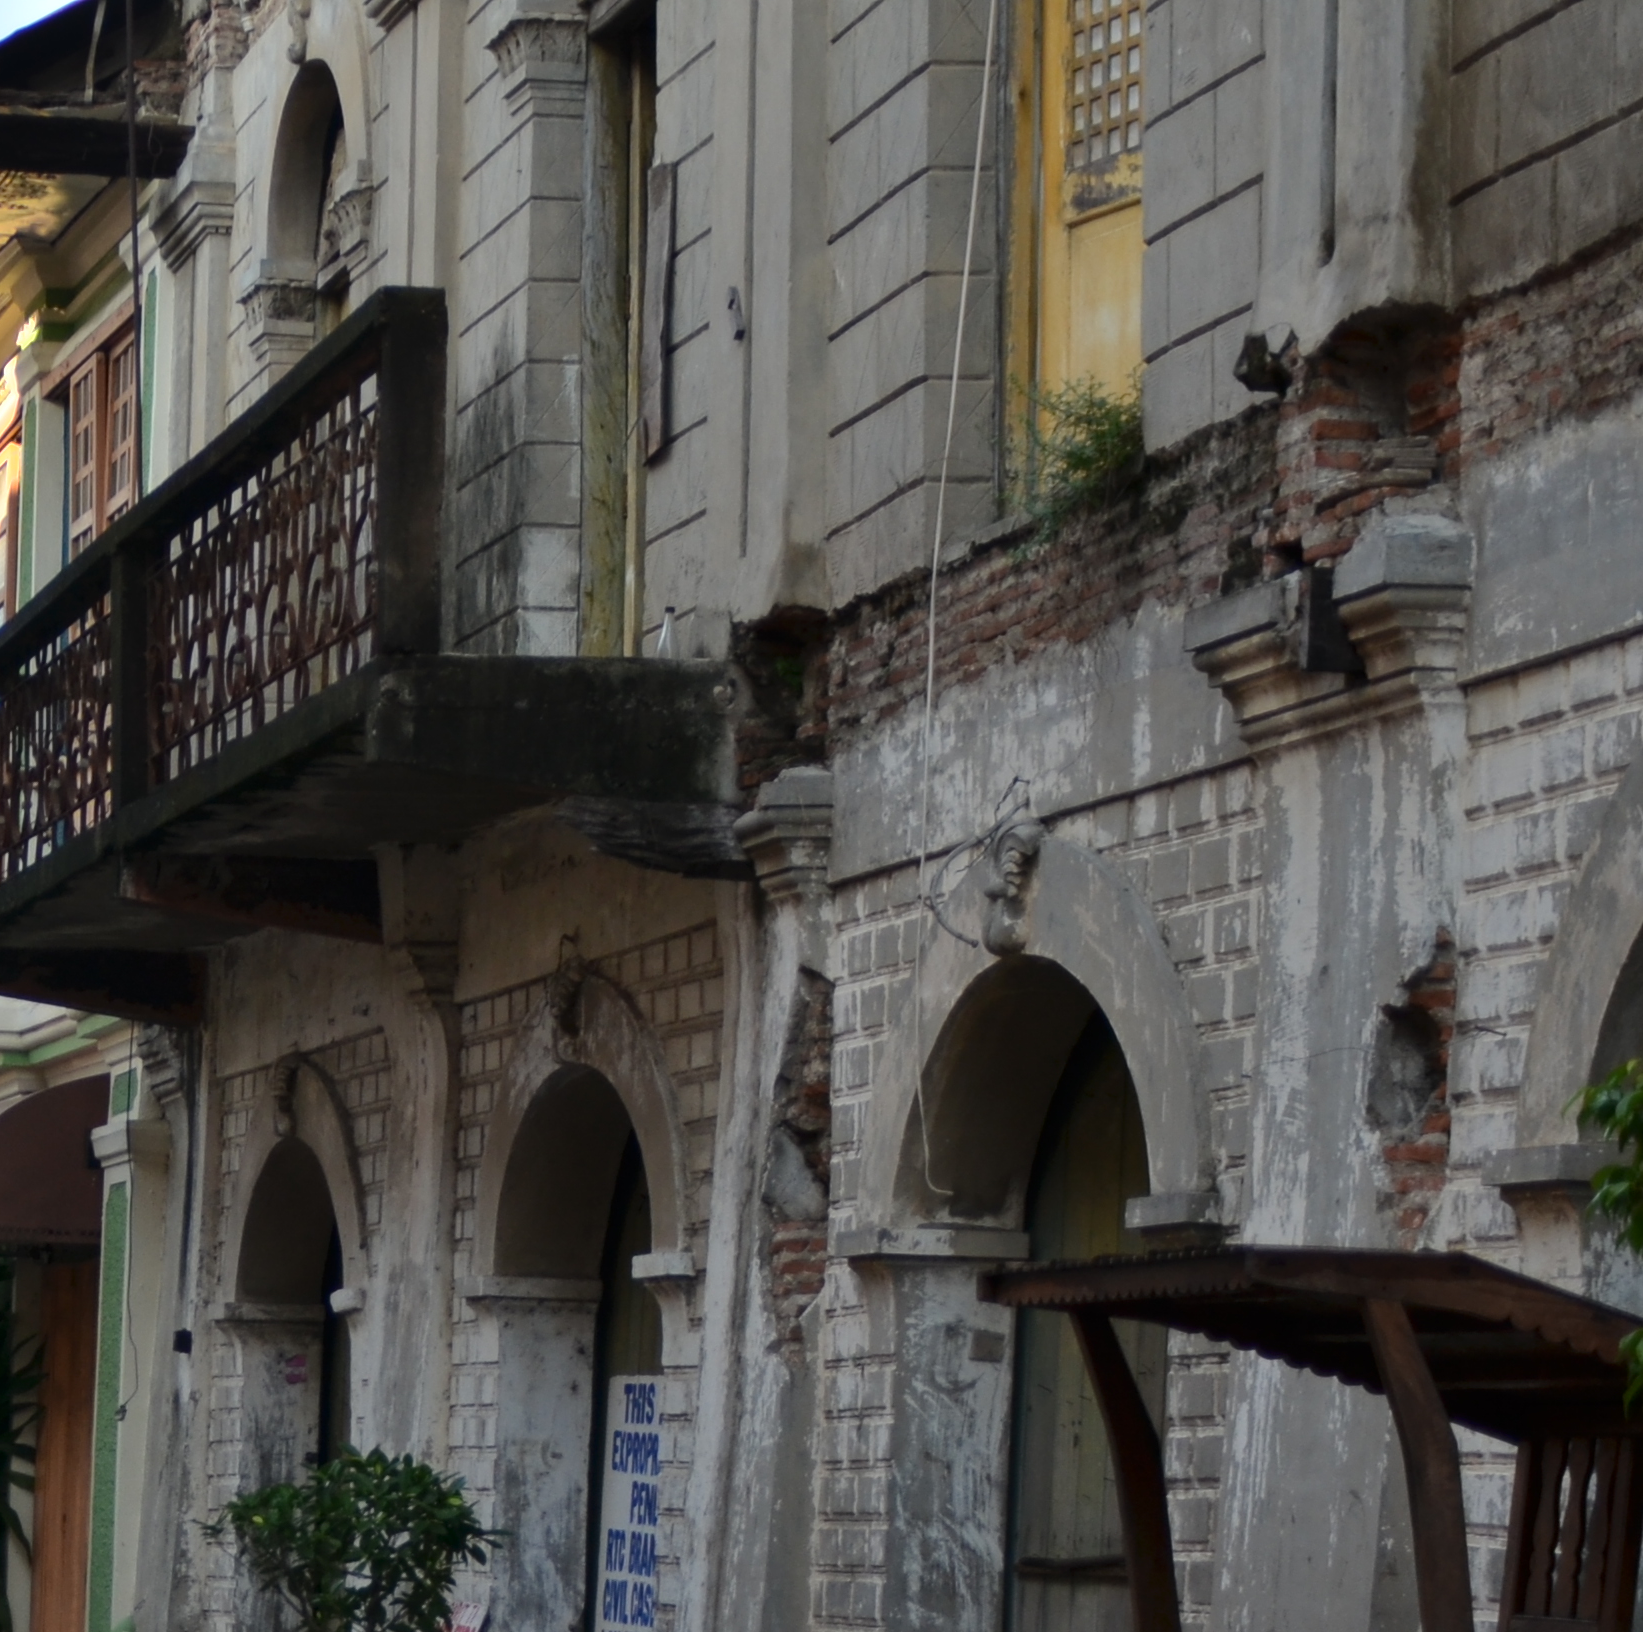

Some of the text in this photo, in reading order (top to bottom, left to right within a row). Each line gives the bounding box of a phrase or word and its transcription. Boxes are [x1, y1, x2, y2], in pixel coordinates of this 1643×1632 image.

[624, 1382, 655, 1424] THIS
[630, 1481, 657, 1526] PEN
[606, 1528, 626, 1572] RTC
[602, 1579, 626, 1624] CIVIL
